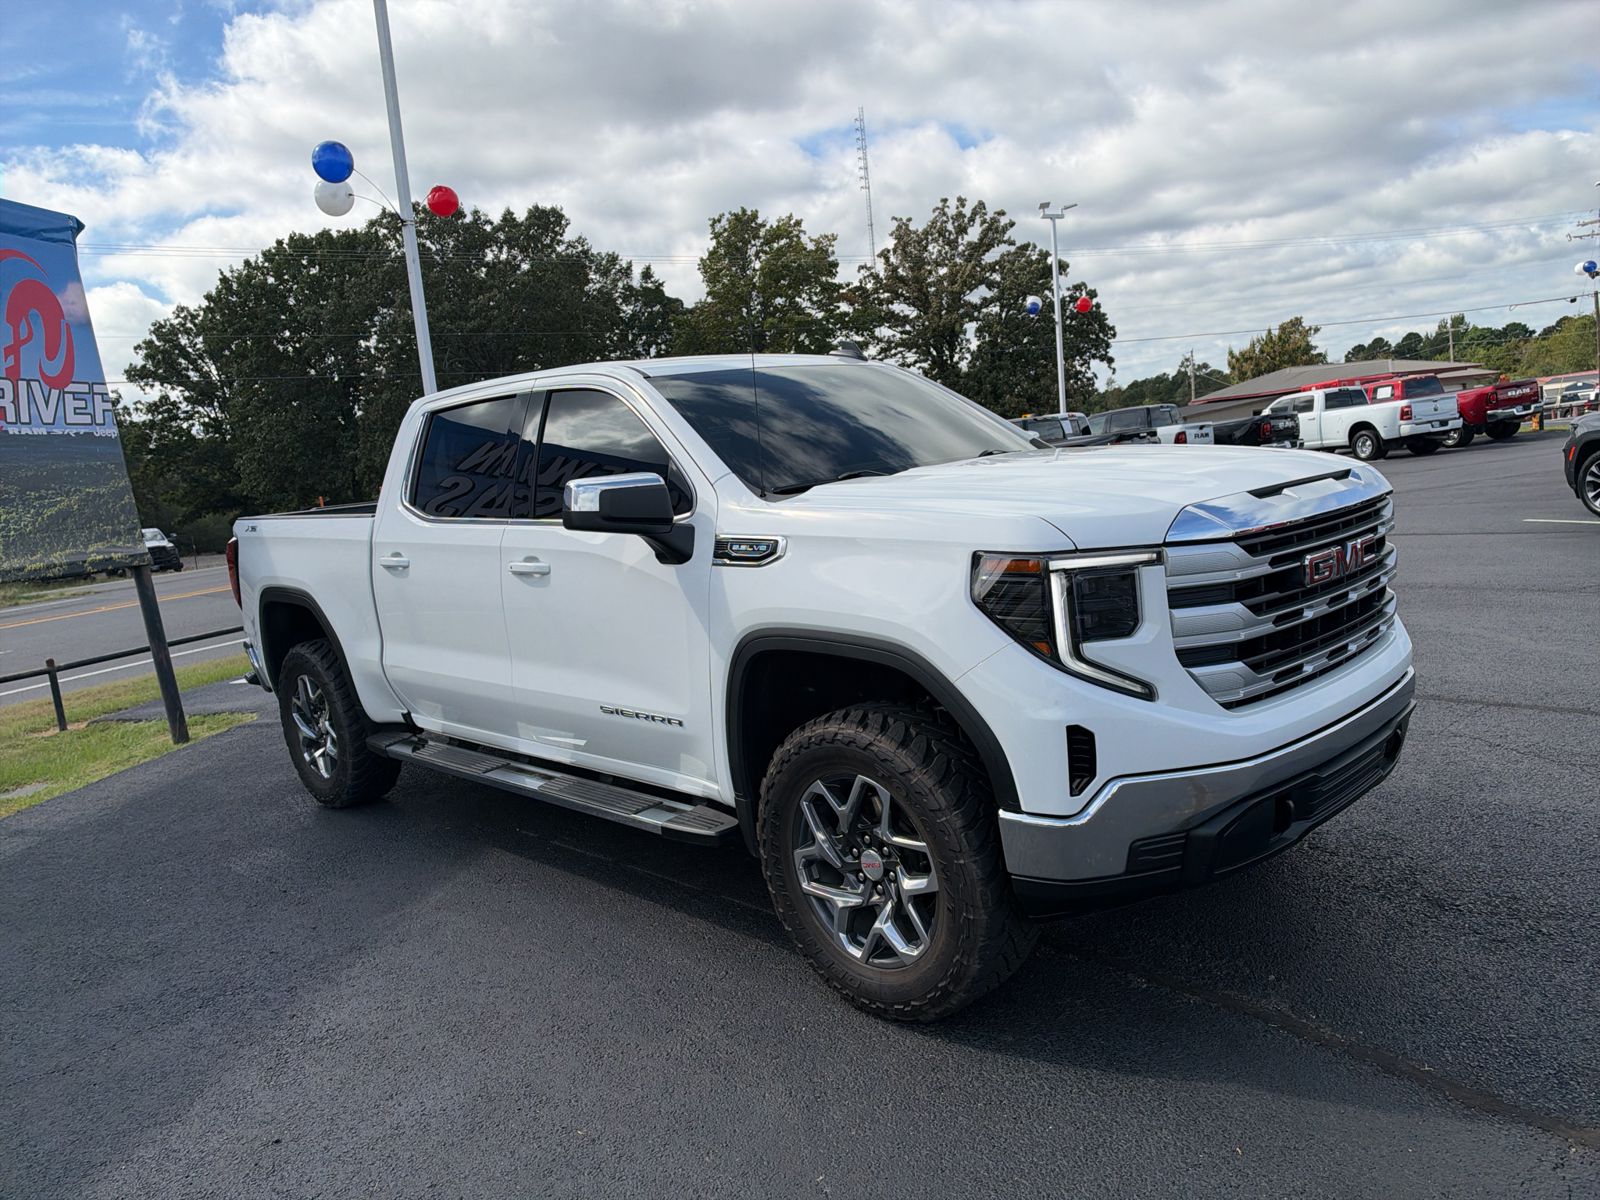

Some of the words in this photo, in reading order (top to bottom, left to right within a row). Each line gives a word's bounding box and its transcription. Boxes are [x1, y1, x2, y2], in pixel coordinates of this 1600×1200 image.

[0, 377, 116, 426] RIVER
[1508, 387, 1531, 396] RAM
[7, 427, 48, 435] RAM
[94, 427, 118, 439] Jeep
[1305, 534, 1376, 587] GMC
[599, 704, 684, 728] SIERRA
